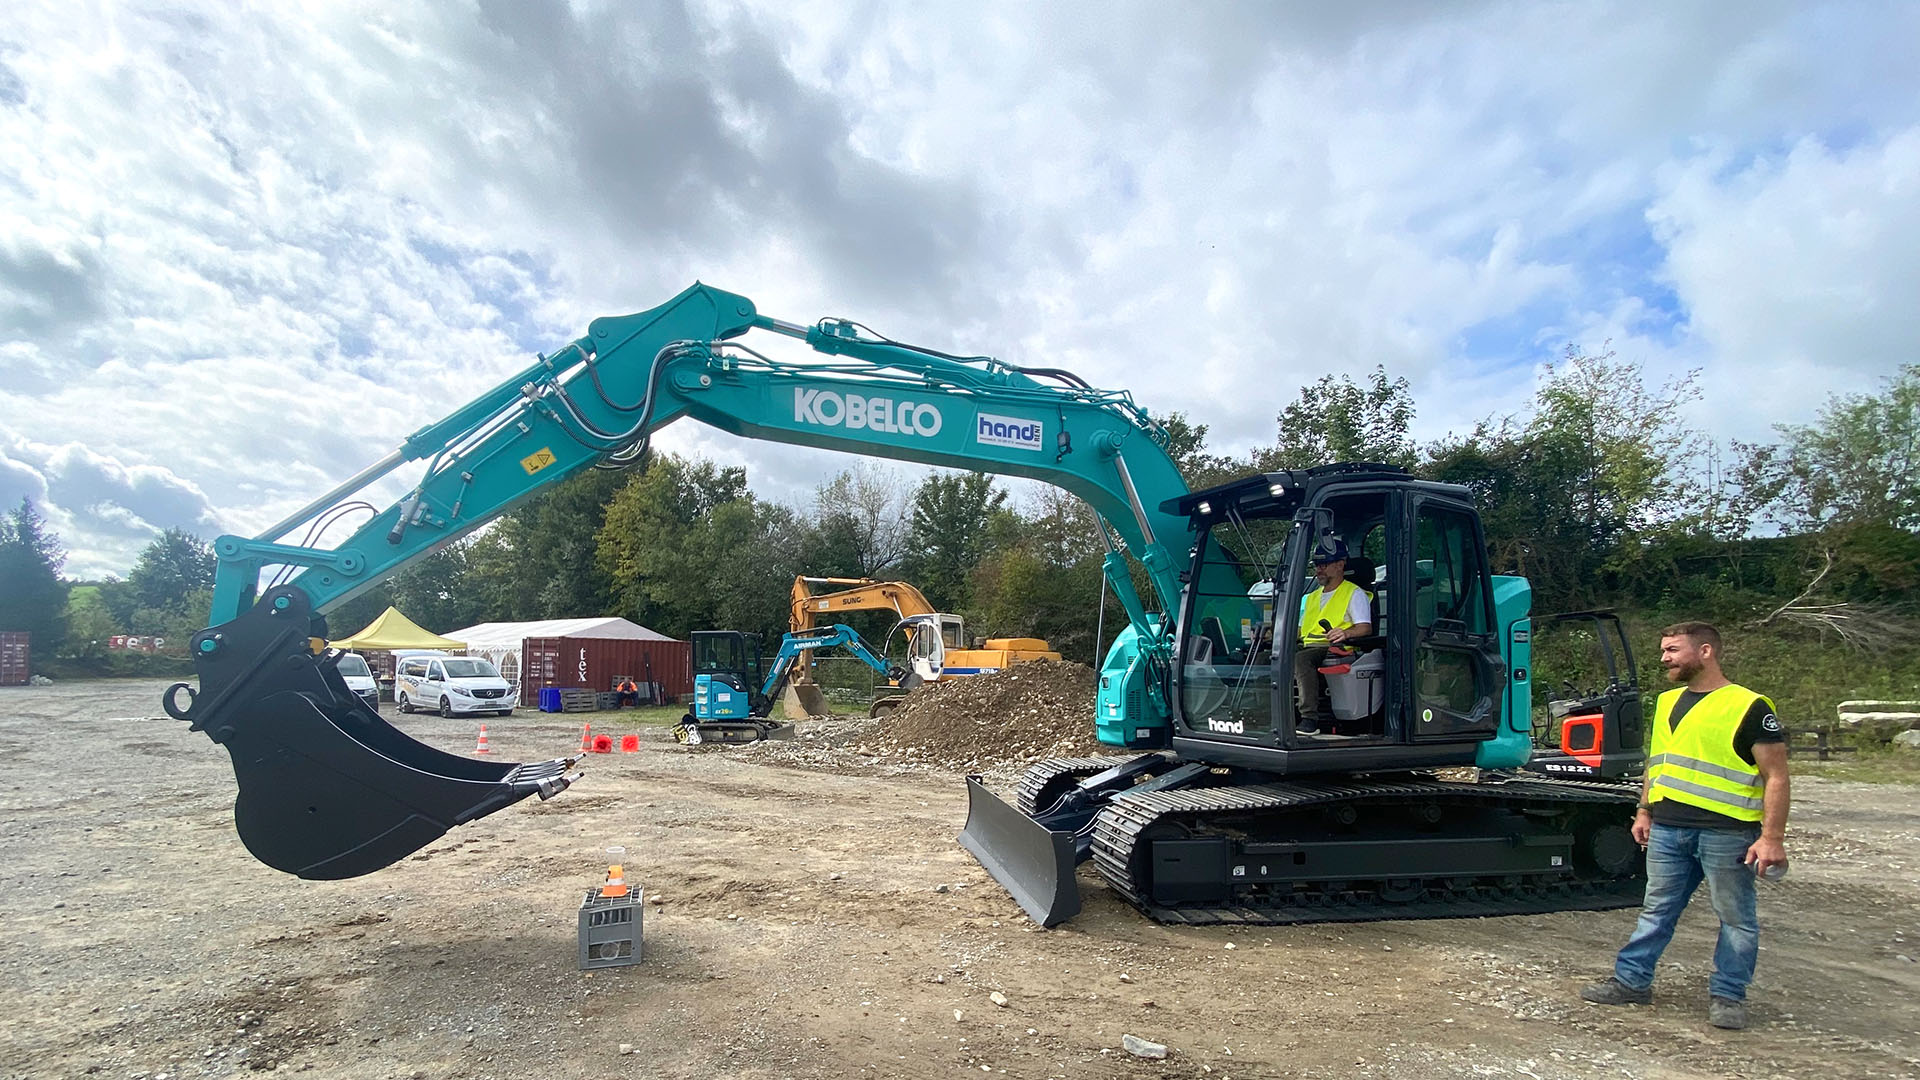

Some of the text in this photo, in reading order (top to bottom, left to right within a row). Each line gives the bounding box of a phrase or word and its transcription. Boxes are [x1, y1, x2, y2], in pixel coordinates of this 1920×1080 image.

[794, 387, 943, 437] KOBELCO
[979, 416, 1035, 441] hand
[793, 640, 822, 650] AIRMAN
[1207, 717, 1244, 734] hand
